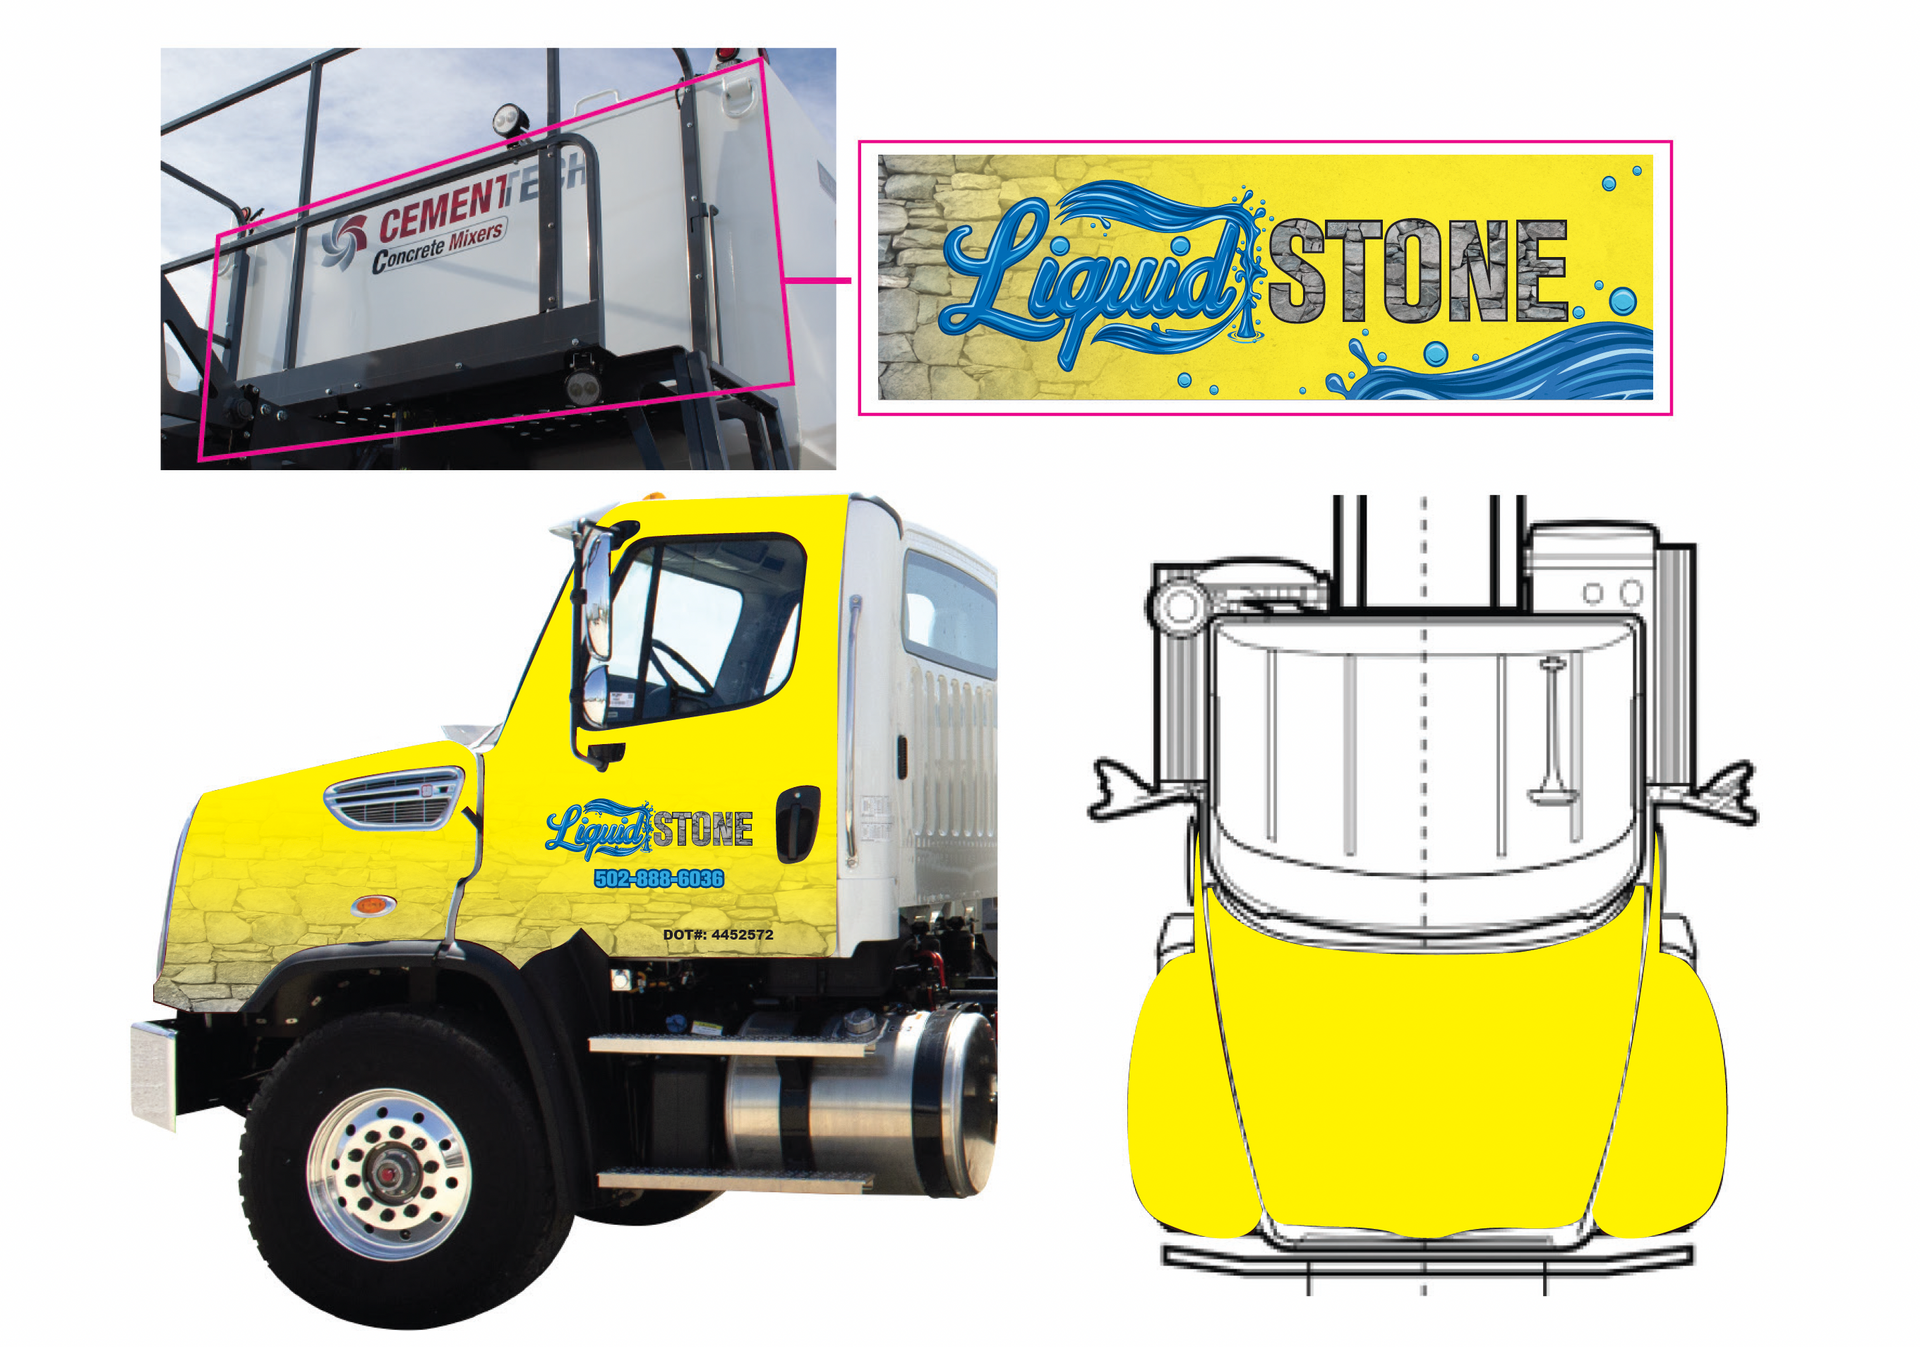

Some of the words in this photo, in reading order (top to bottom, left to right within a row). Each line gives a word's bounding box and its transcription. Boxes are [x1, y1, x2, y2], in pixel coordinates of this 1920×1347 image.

[372, 239, 445, 275] Concrete
[449, 222, 503, 251] Mixers
[938, 196, 1240, 372] Liquid
[1268, 217, 1569, 324] STONE
[545, 804, 645, 862] Liquid
[653, 811, 753, 847] STONE
[594, 868, 725, 889] 502-888-6036
[664, 929, 707, 941] DOT#:
[711, 929, 774, 941] 4452572
